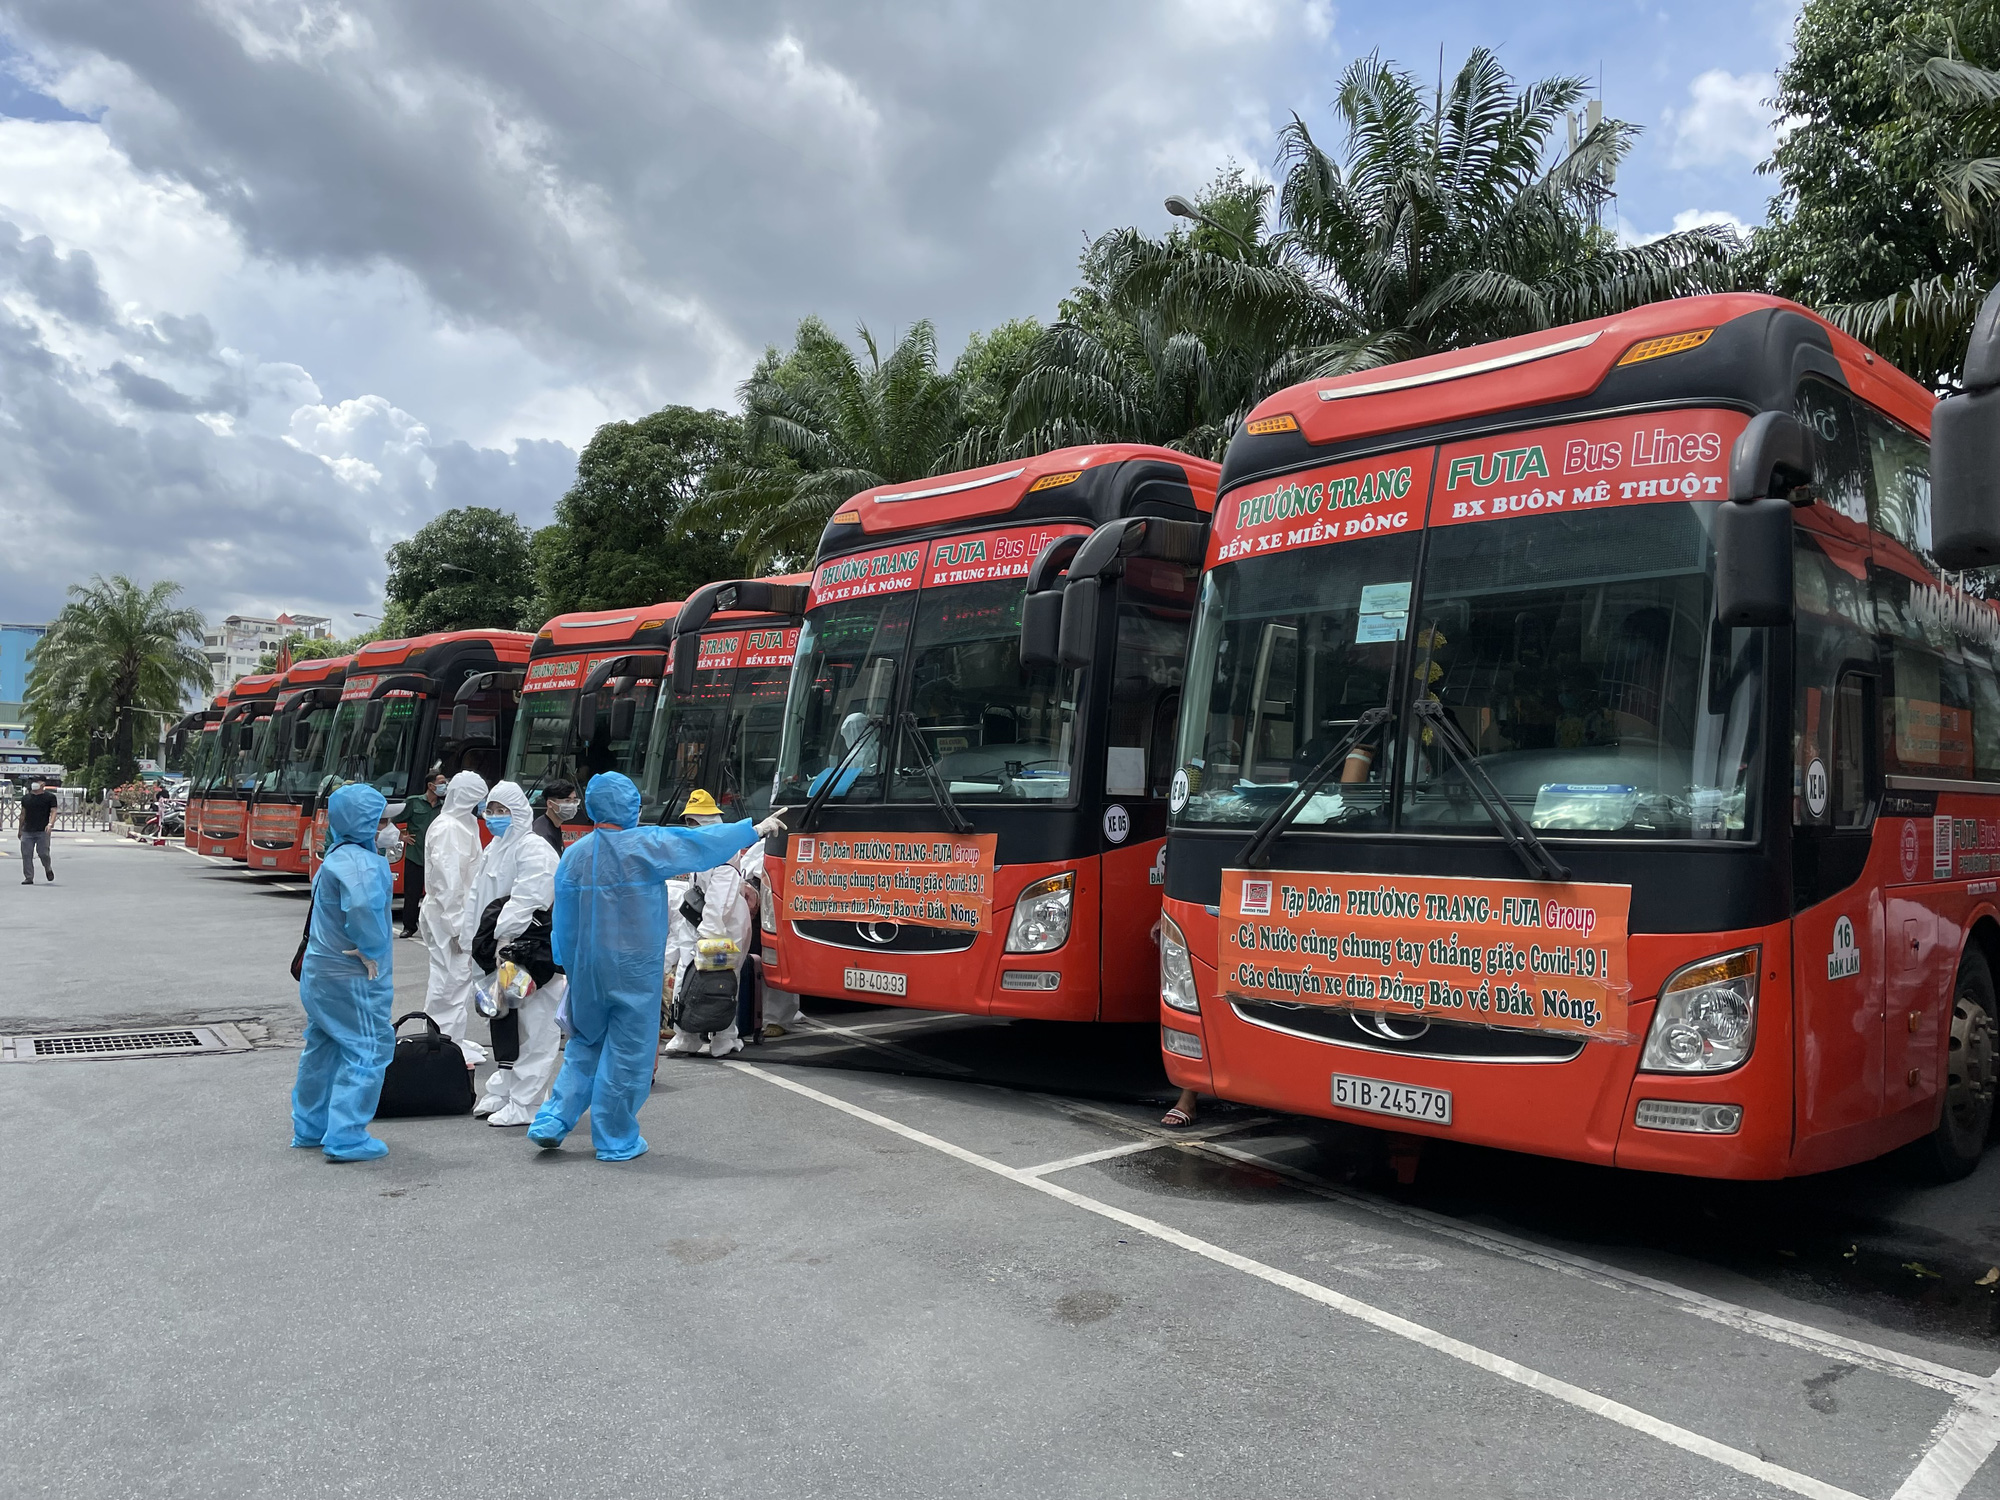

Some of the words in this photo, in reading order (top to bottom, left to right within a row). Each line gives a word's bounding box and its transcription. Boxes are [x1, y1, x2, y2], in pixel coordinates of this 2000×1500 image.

[1447, 446, 1549, 491] FUTA
[1563, 439, 1622, 476] Bus
[1631, 429, 1721, 467] Lines
[1236, 482, 1323, 529] PHƯƠNG
[1327, 466, 1411, 510] TRANG
[1452, 499, 1486, 519] BX
[1491, 488, 1566, 514] BUÔN
[1571, 480, 1610, 505] MÊ
[1620, 472, 1722, 499] THUỘT
[1218, 533, 1253, 560] BẾN
[1256, 532, 1283, 551] XE
[1286, 518, 1340, 546] MIỀN
[1344, 512, 1409, 536] ĐÔNG
[933, 540, 986, 567] FUTA
[993, 537, 1024, 560] Bus
[820, 558, 869, 588] PHƯƠNG
[870, 550, 919, 577] TRANG
[933, 572, 948, 584] BX
[949, 567, 985, 582] TRUNG
[987, 563, 1011, 577] TÂM
[816, 588, 835, 604] BẾN
[835, 587, 851, 599] XE
[878, 577, 912, 592] NÔNG
[705, 637, 739, 655] TRANG
[747, 631, 784, 650] FUTA
[555, 661, 580, 676] TRANG
[714, 657, 733, 667] TÂY
[745, 653, 764, 666] BẾN
[764, 655, 777, 665] XE
[778, 655, 794, 666] TỊN
[533, 682, 542, 690] XE
[1809, 774, 1817, 799] XE
[1818, 774, 1825, 799] 04
[1108, 816, 1116, 832] XE
[1118, 815, 1127, 831] 05
[1953, 819, 1978, 850] FUTA
[819, 841, 832, 863] Tập
[853, 839, 891, 861] PHƯƠNG
[894, 843, 927, 862] TRANG
[932, 843, 953, 863] FUTA
[954, 844, 980, 868] Group
[806, 869, 827, 887] Nước
[828, 869, 847, 891] cùng
[849, 869, 876, 892] chung
[877, 872, 892, 892] tay
[894, 867, 921, 894] thắng
[923, 872, 943, 895] giặc
[945, 873, 978, 893] Covid-19
[839, 900, 850, 913] xe
[927, 898, 947, 919] Đắk
[1281, 886, 1304, 918] Tập
[1307, 886, 1341, 914] Đoàn
[1346, 885, 1420, 919] PHƯƠNG
[1425, 893, 1490, 923] TRANG
[1501, 897, 1541, 927] FUTA
[1545, 899, 1596, 938] Group
[1838, 923, 1850, 948] 16
[1259, 926, 1297, 952] Nước
[1300, 929, 1338, 961] cùng
[1342, 932, 1392, 966] chung
[1395, 937, 1424, 968] tay
[1428, 932, 1482, 974] thắng
[1486, 942, 1526, 976] giặc
[1529, 944, 1596, 977] Covid-19
[1829, 952, 1844, 977] ĐẮK
[1846, 949, 1859, 974] LẮK
[1267, 965, 1321, 996] chuyến
[1324, 975, 1342, 996] xe
[1346, 973, 1375, 999] đưa
[1379, 971, 1425, 1009] Đồng
[1467, 979, 1490, 1011] về
[1495, 982, 1535, 1016] Đắk
[1542, 989, 1602, 1027] Nông.
